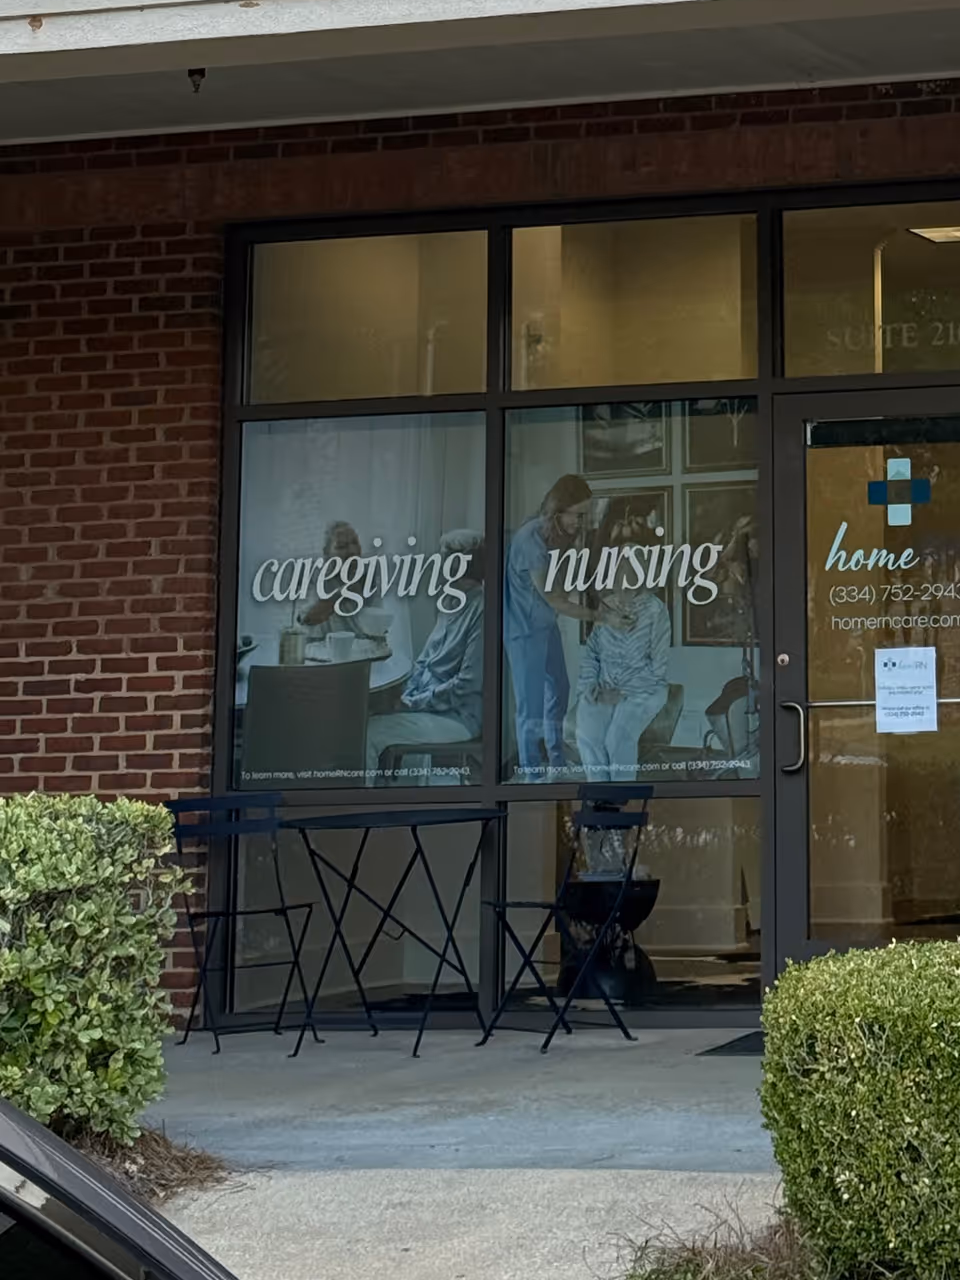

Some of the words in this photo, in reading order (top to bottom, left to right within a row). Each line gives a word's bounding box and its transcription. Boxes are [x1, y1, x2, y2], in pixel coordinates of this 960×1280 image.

[824, 521, 920, 572] home
[252, 536, 473, 617] caregiving
[544, 526, 723, 606] nursing
[829, 584, 876, 606] (334)
[241, 771, 251, 780] To
[296, 770, 312, 779] visit
[384, 769, 393, 777] or
[394, 768, 408, 776] call
[409, 767, 431, 777] (334)
[671, 761, 686, 770] call
[687, 760, 709, 770] (334)
